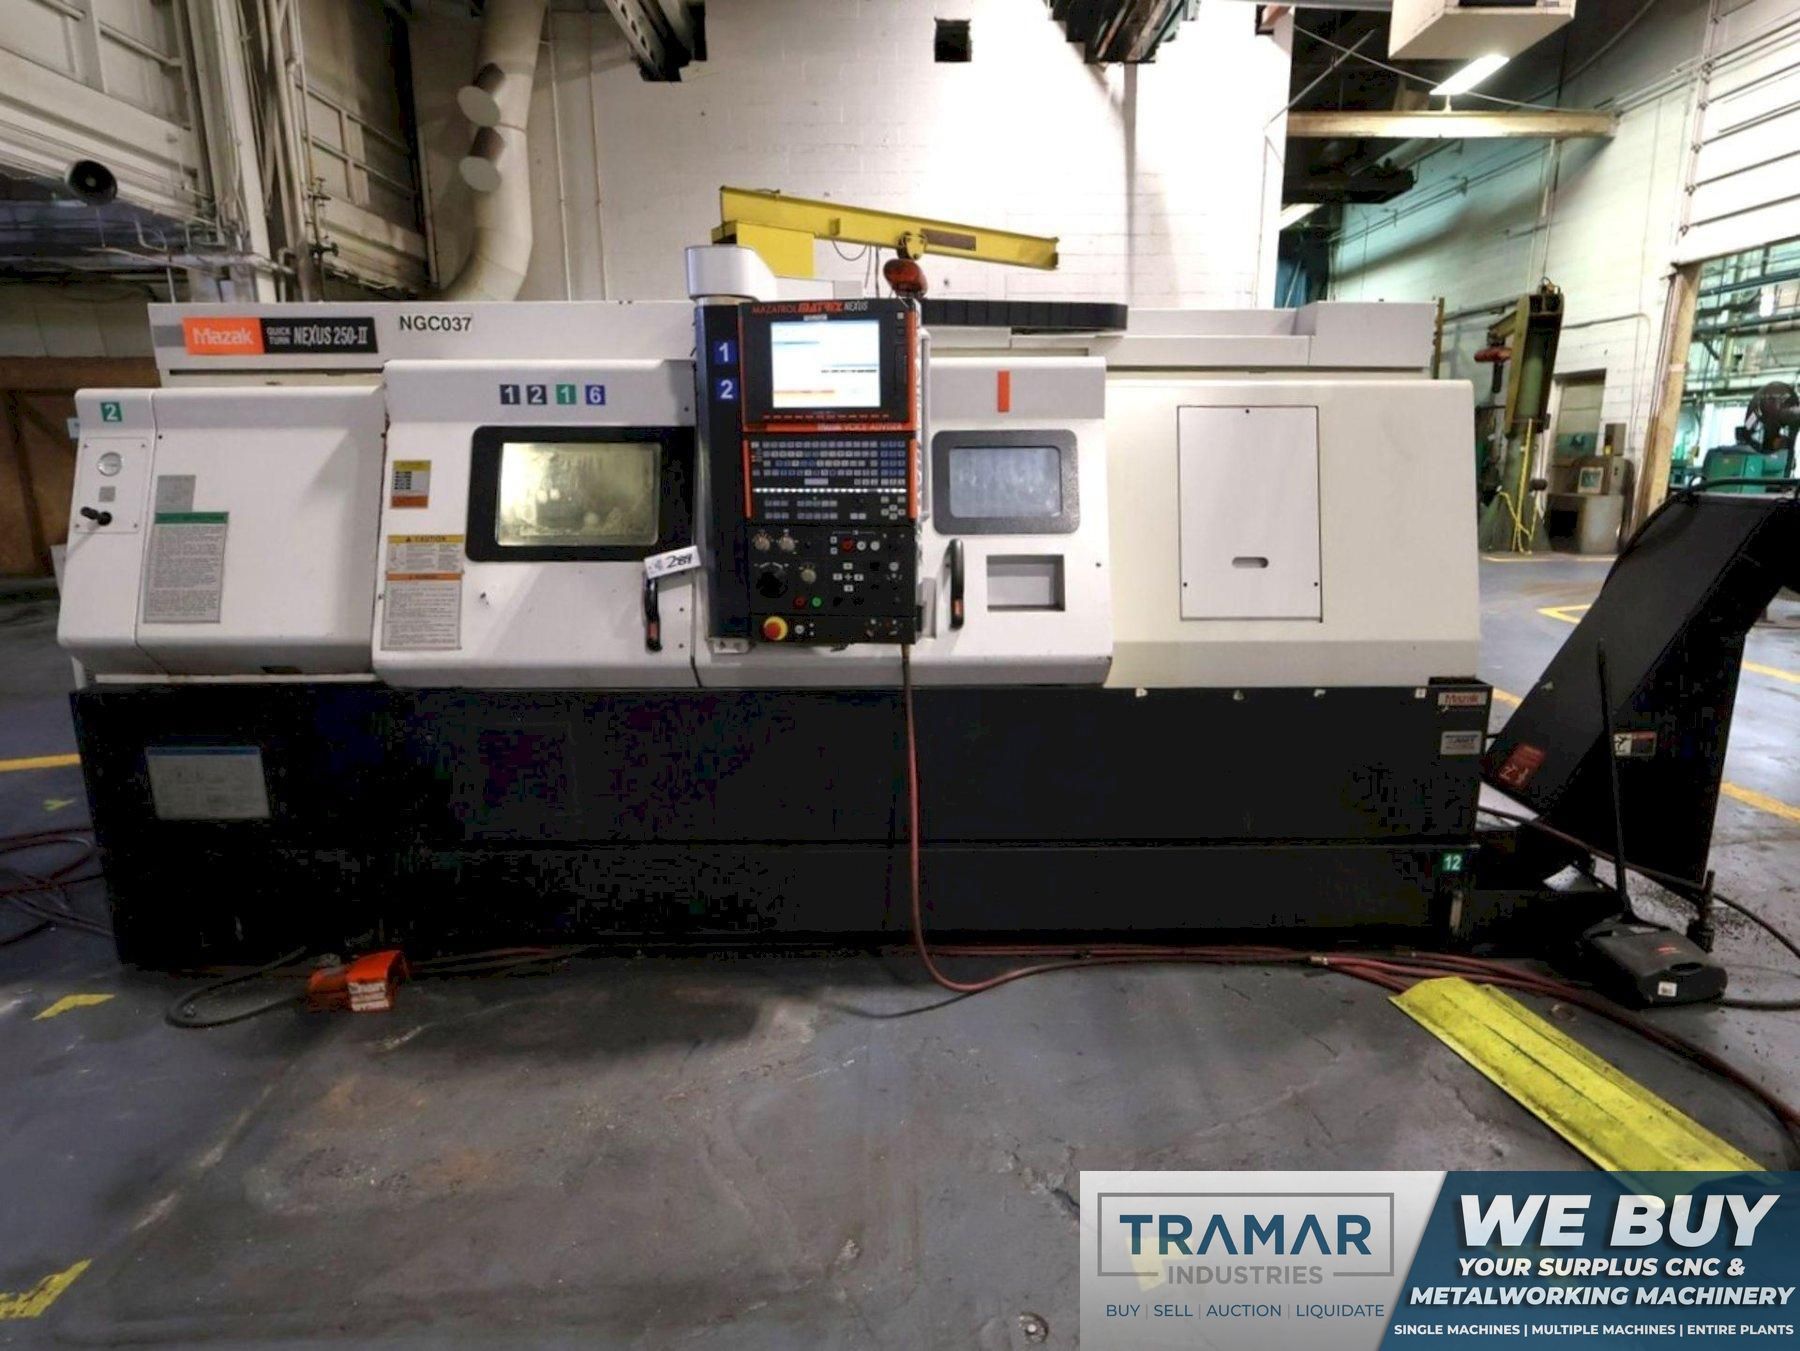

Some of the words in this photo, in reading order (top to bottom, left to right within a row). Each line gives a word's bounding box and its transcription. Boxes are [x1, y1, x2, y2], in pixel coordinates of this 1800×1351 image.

[844, 300, 868, 312] NEXUS
[267, 326, 292, 336] QUICK
[400, 315, 472, 331] NGC037
[192, 326, 254, 345] Mazak
[269, 336, 292, 345] TURN
[293, 324, 332, 346] NEXUS
[718, 342, 729, 362] 1
[504, 385, 515, 404] 1
[530, 385, 544, 404] 2
[561, 385, 570, 404] 1
[589, 386, 602, 404] 6
[720, 379, 734, 399] 2
[104, 403, 118, 420] 2
[1444, 854, 1461, 870] 12
